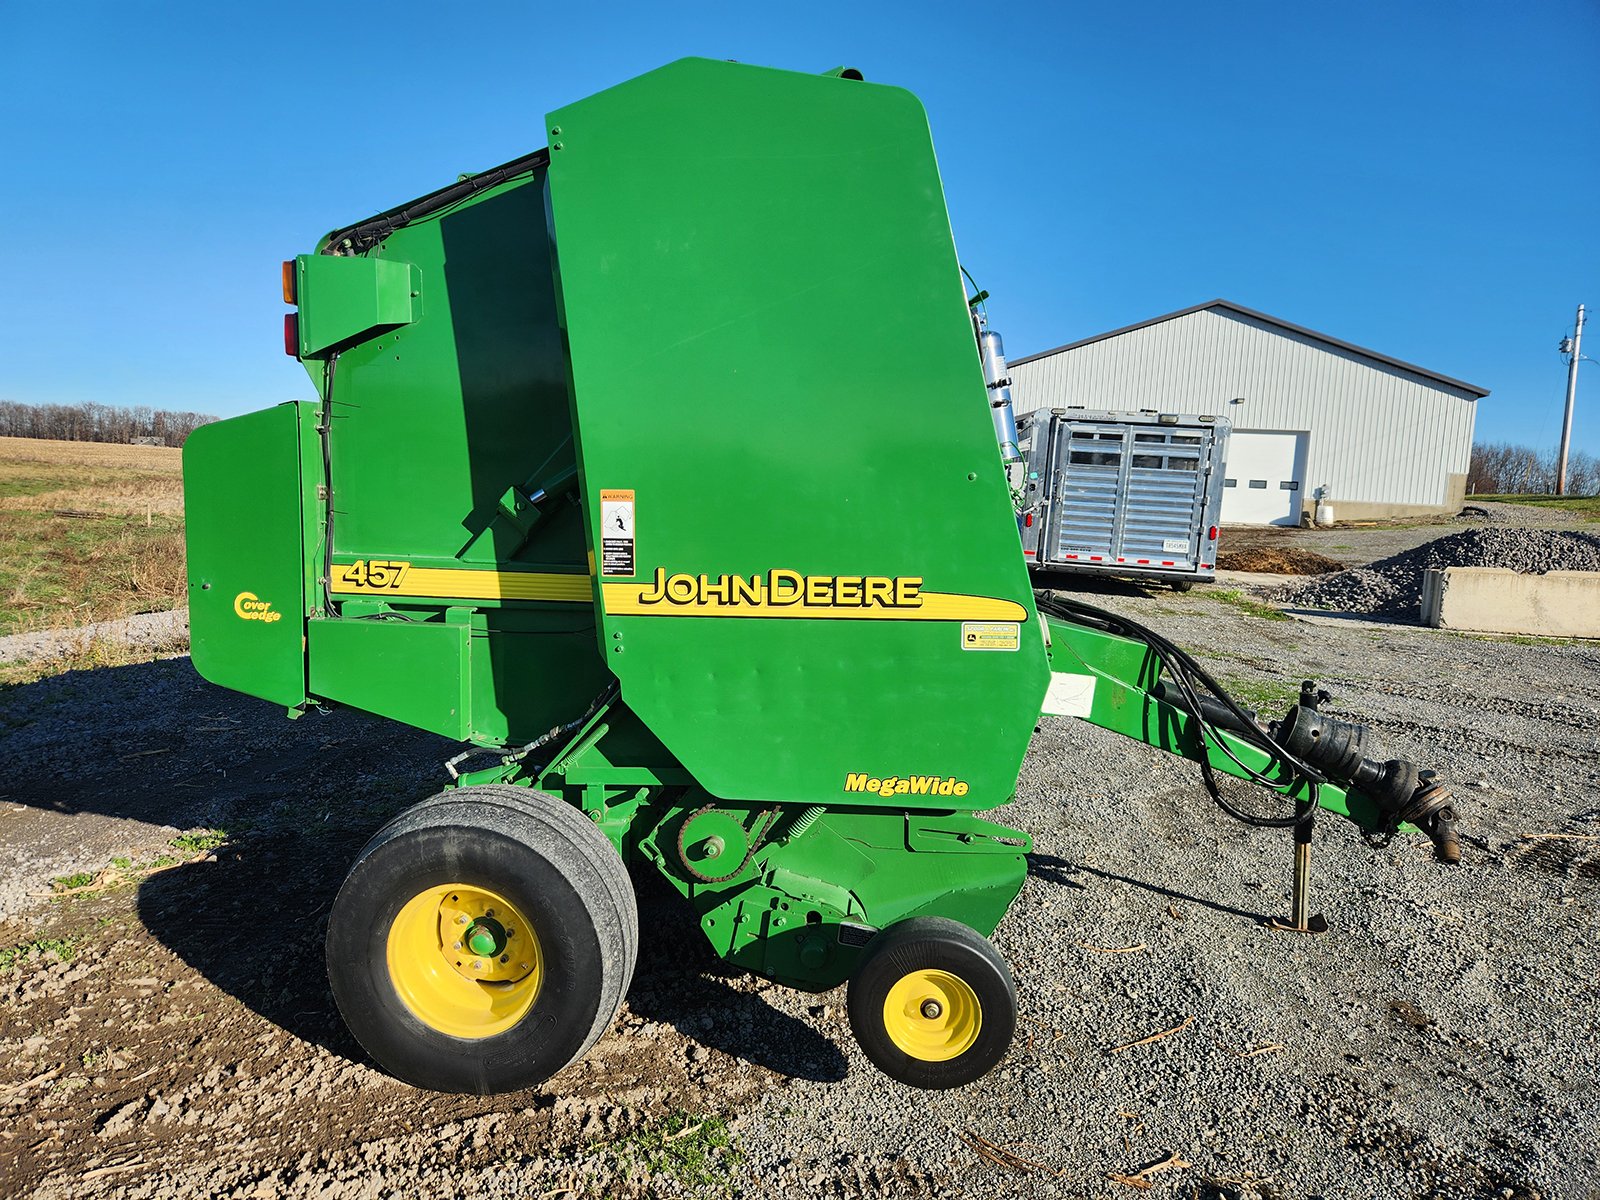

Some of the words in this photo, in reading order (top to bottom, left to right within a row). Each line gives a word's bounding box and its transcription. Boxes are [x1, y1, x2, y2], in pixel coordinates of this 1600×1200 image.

[342, 559, 410, 588] 457
[639, 567, 761, 605] JOHN
[767, 569, 923, 607] DEERE
[844, 773, 969, 797] MegaWide
